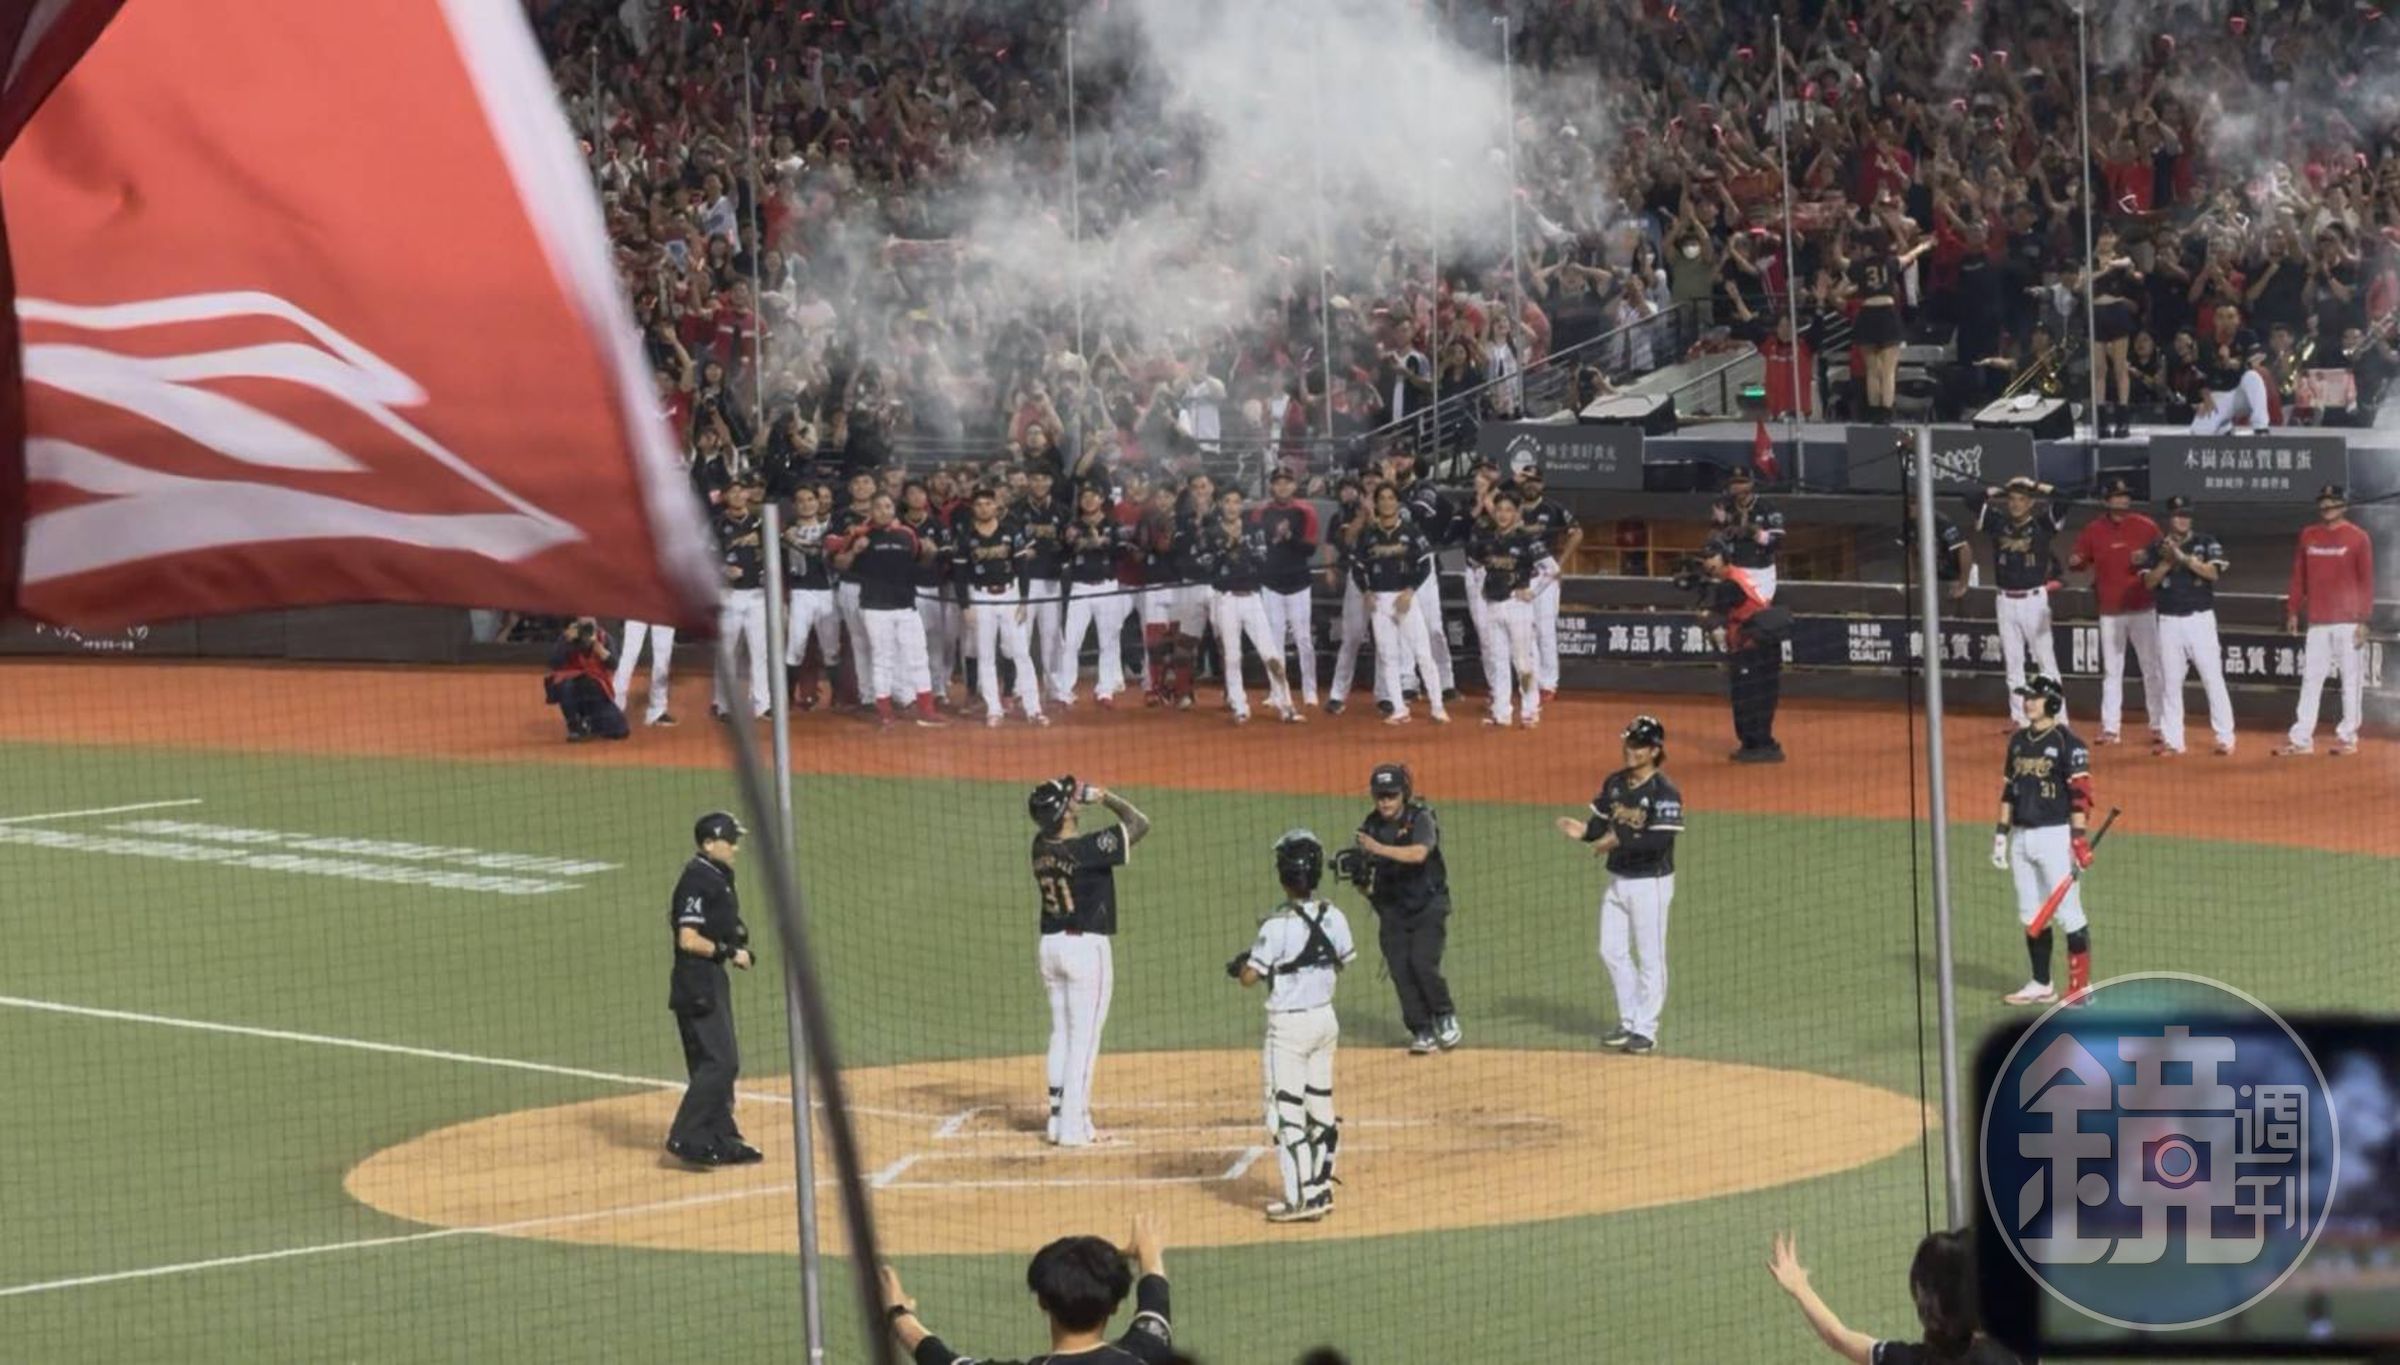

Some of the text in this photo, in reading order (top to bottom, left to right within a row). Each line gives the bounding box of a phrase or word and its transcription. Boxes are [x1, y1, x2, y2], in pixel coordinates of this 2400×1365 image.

[1608, 625, 1673, 653] 高品質
[1849, 649, 1892, 661] QUALITY
[2225, 646, 2267, 675] 品質
[684, 896, 702, 913] 24
[1040, 877, 1075, 914] 31
